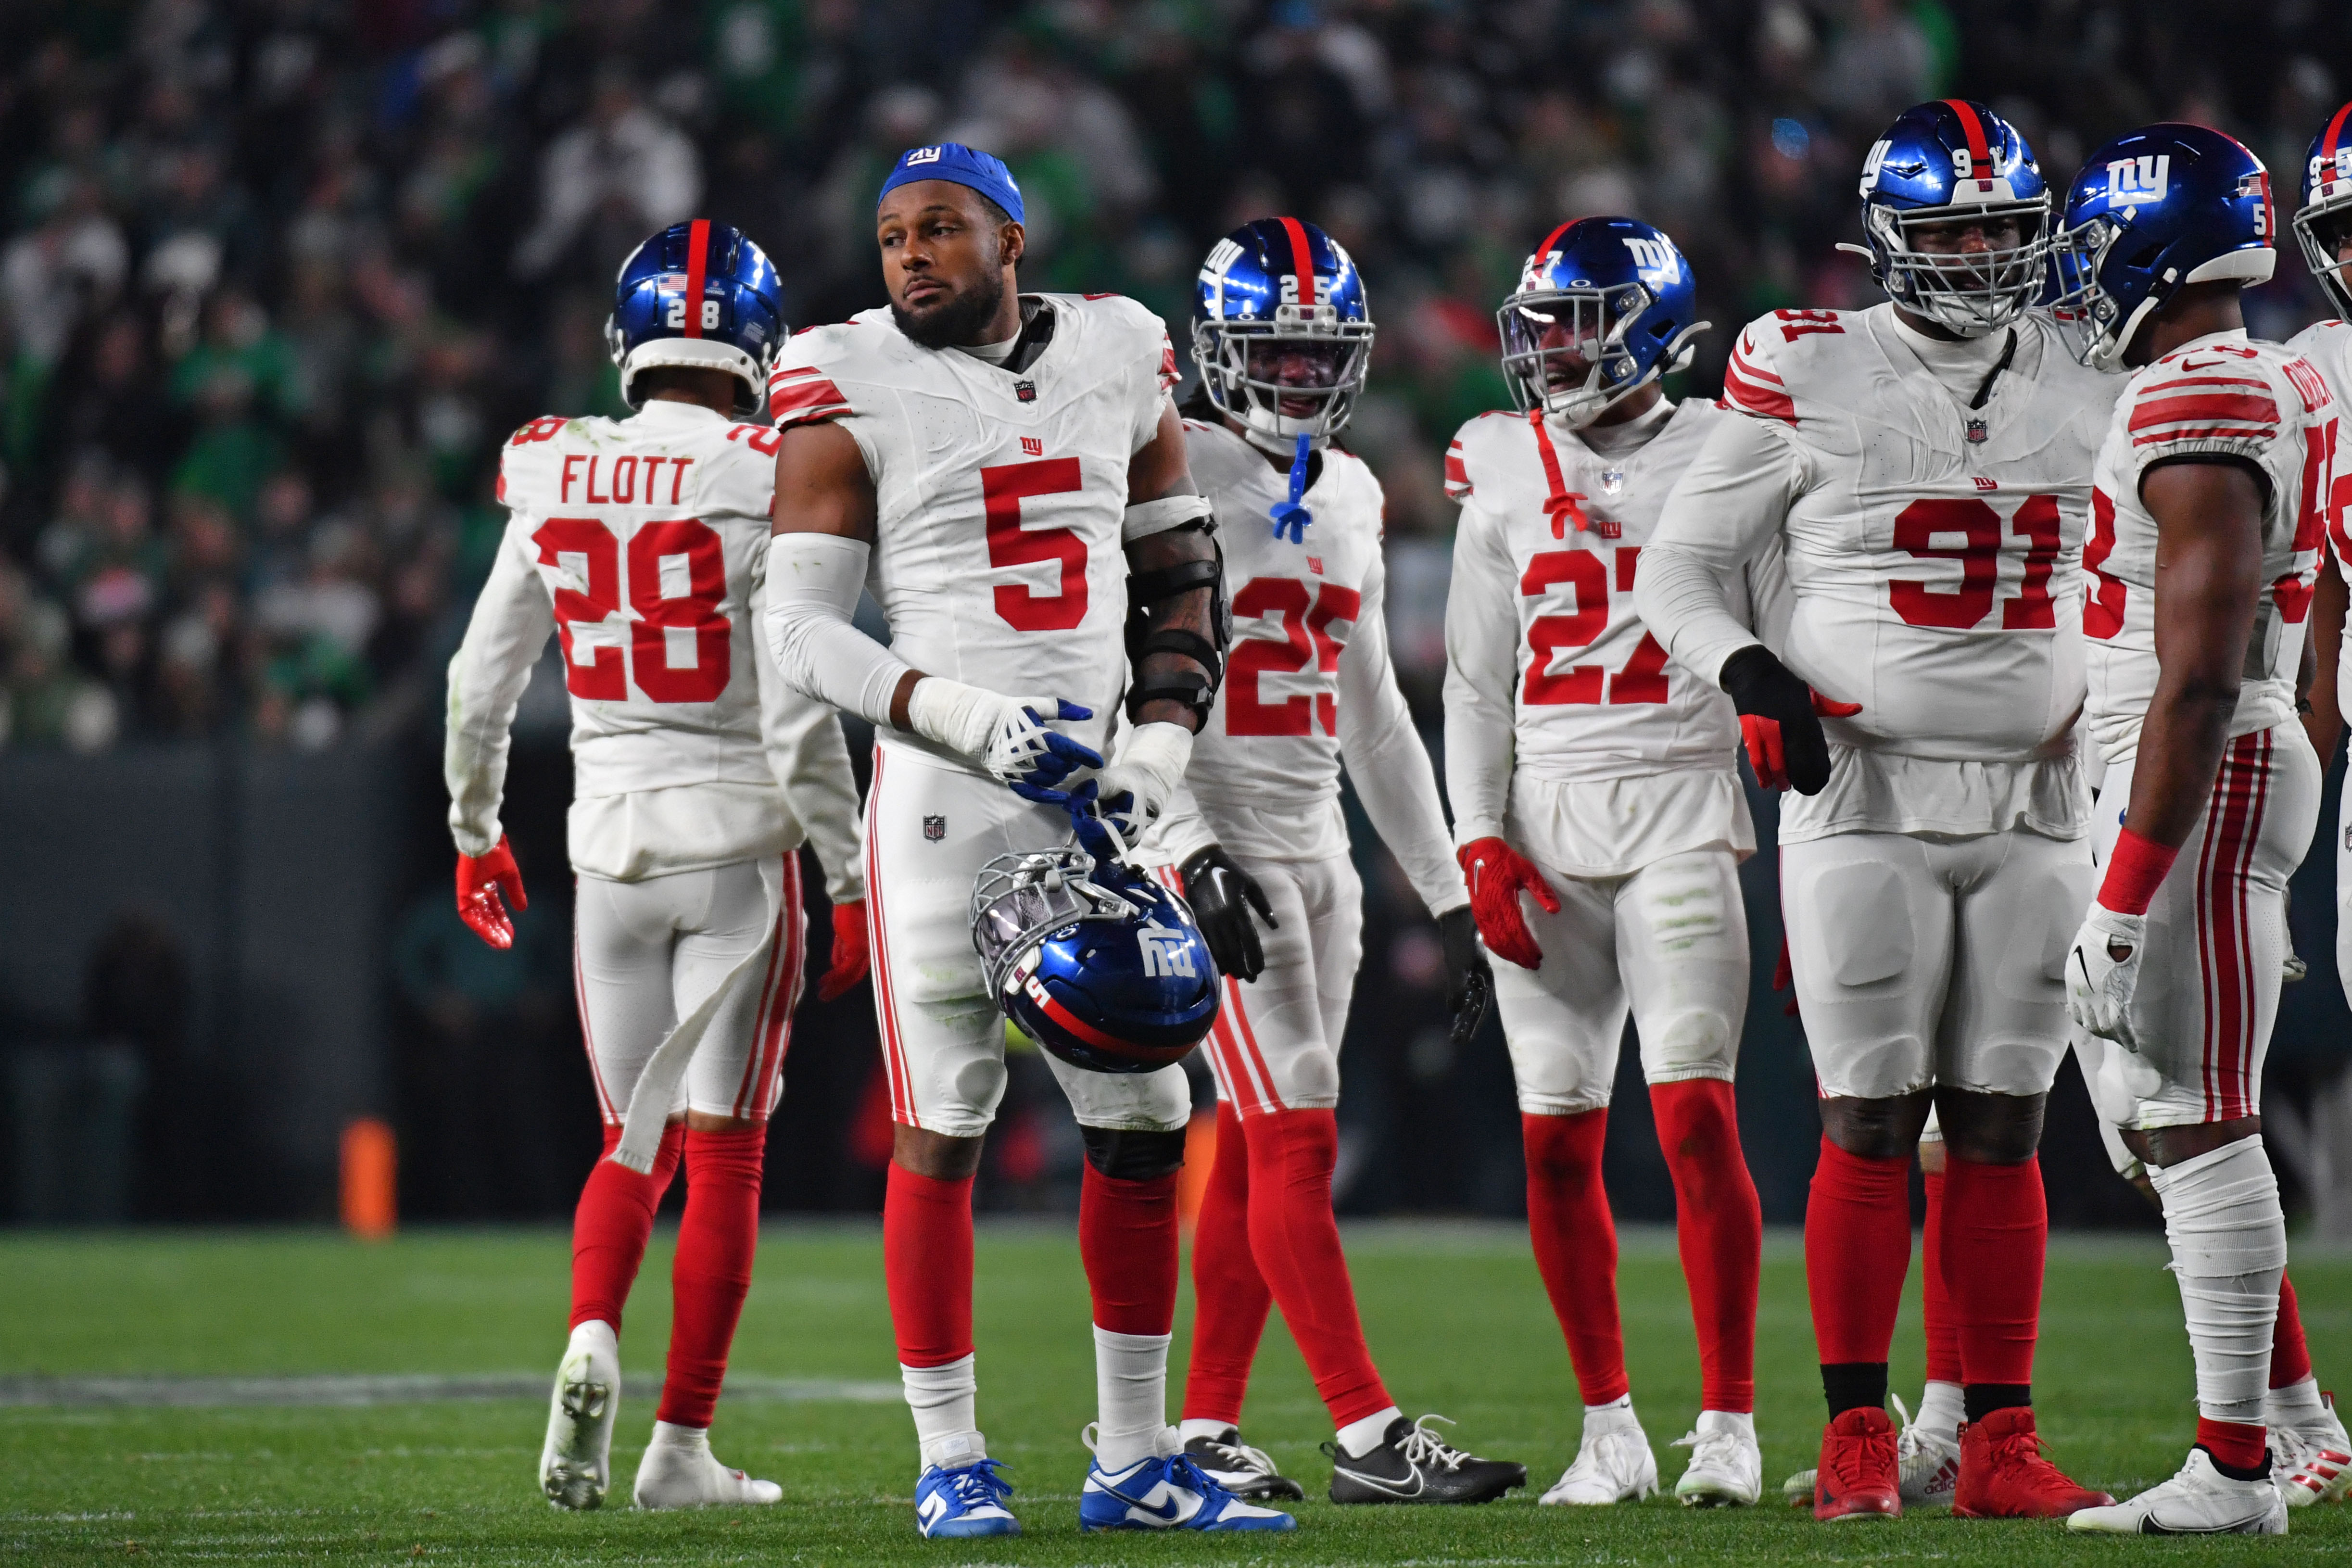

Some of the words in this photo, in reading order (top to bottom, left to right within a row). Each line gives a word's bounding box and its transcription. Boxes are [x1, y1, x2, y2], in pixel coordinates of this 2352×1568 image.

[1953, 147, 2005, 177] 91
[2309, 146, 2352, 187] 95
[1521, 250, 1563, 283] 27
[1280, 275, 1330, 304] 25
[668, 298, 720, 329] 28
[561, 455, 694, 505] FLOTT
[980, 456, 1087, 631] 5
[1889, 495, 2061, 630] 91
[531, 517, 731, 703] 28
[1520, 546, 1669, 705] 27
[1025, 976, 1051, 1009] 5
